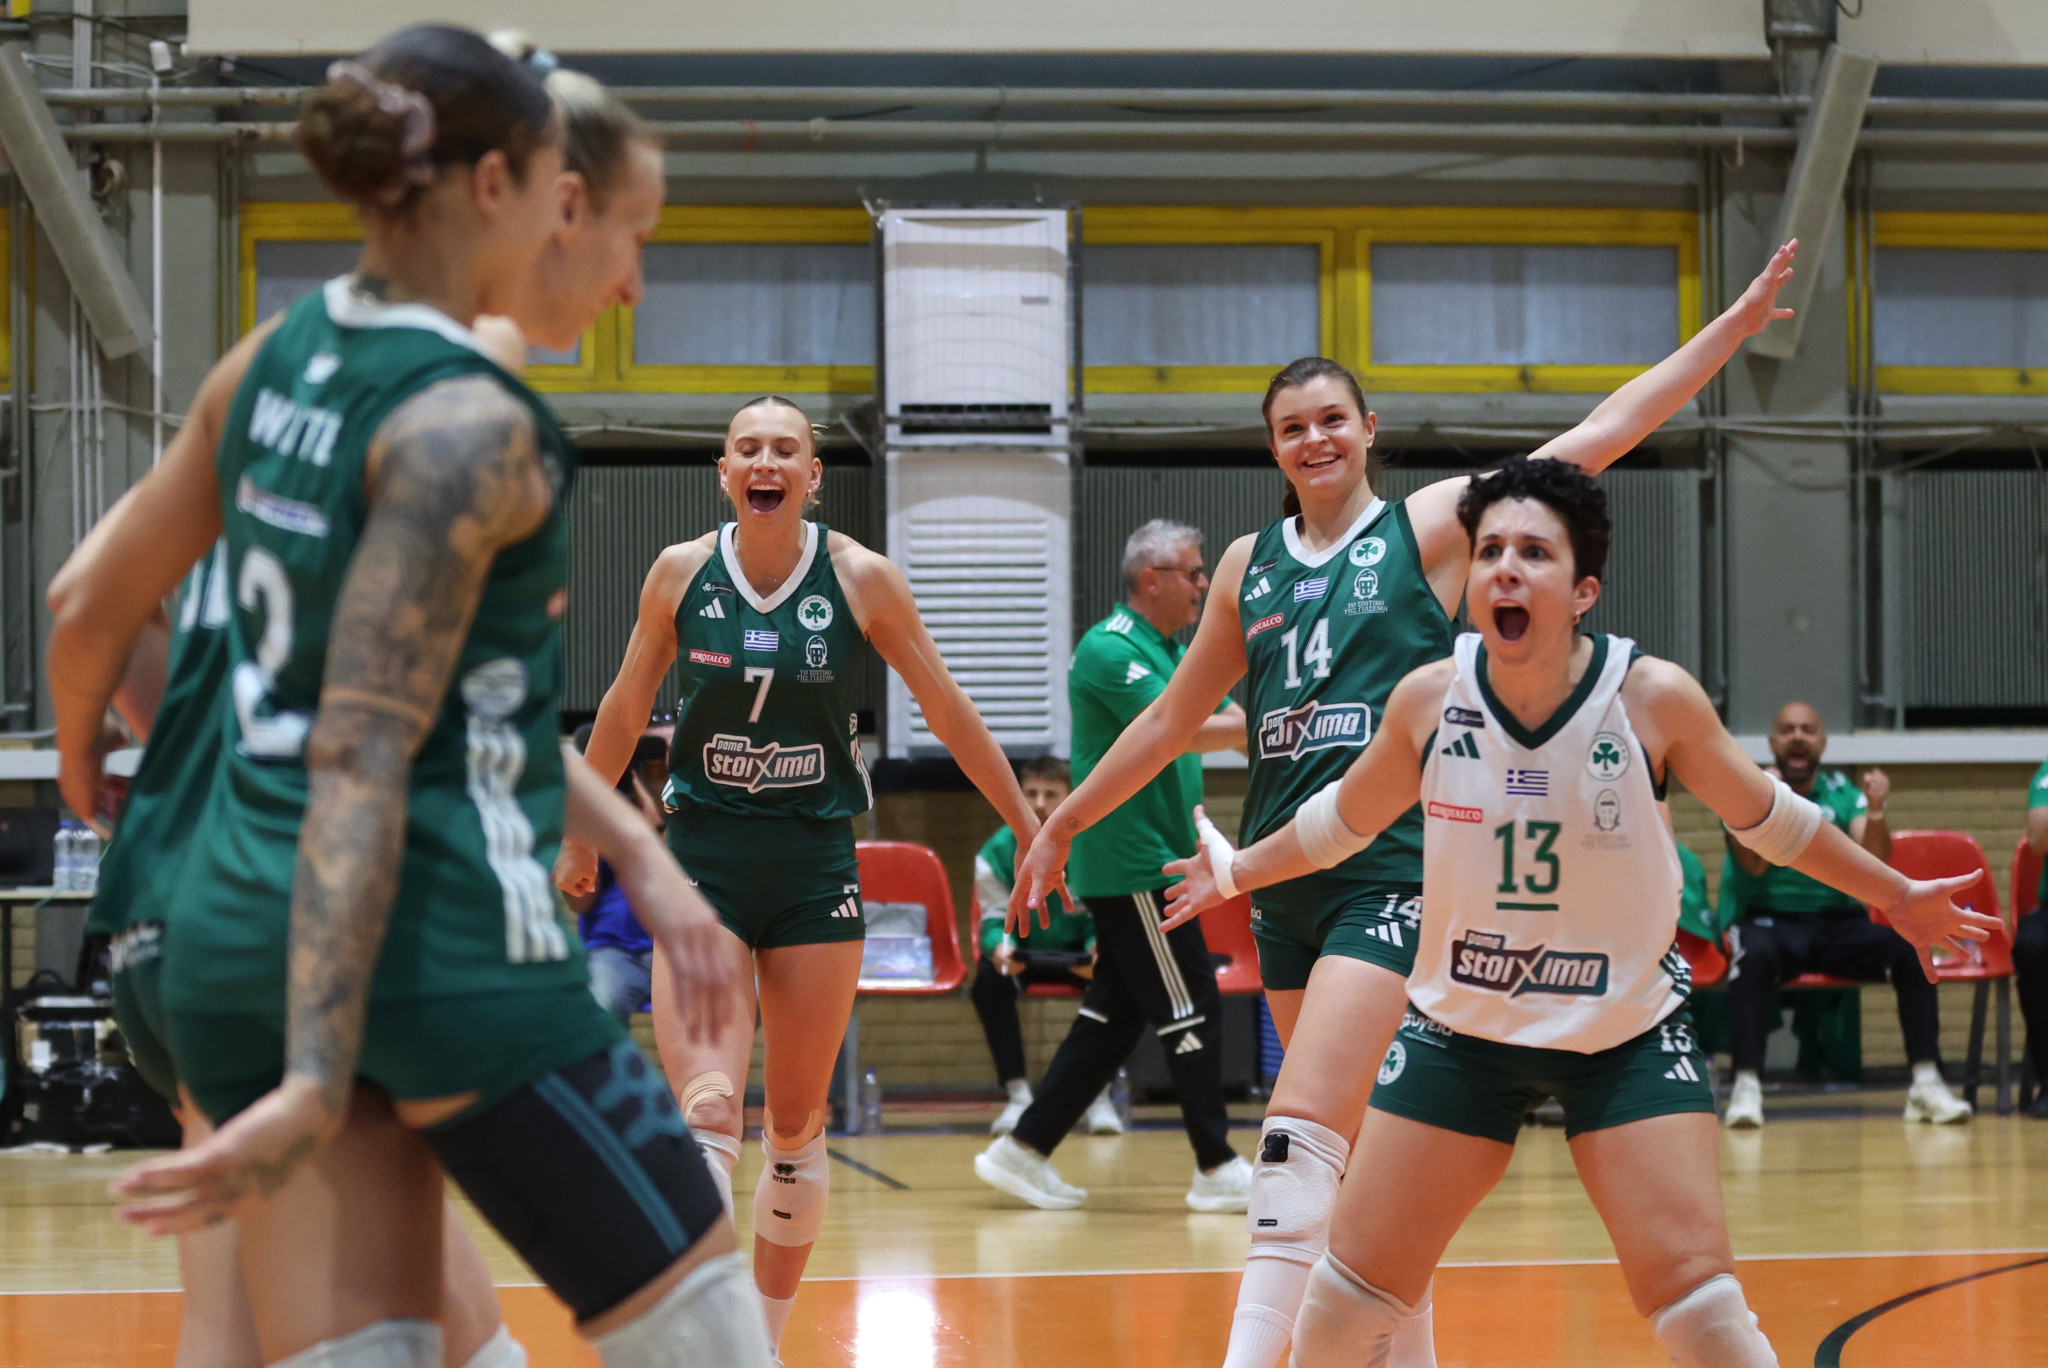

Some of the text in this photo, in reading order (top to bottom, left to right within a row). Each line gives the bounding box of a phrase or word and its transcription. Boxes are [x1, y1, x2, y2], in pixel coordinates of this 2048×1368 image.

[232, 546, 310, 757] 2
[691, 651, 730, 665] BOROTALCO
[1281, 618, 1333, 689] 14
[743, 667, 775, 723] 7
[717, 740, 744, 752] pame
[1495, 820, 1562, 894] 13
[1378, 894, 1423, 930] 14
